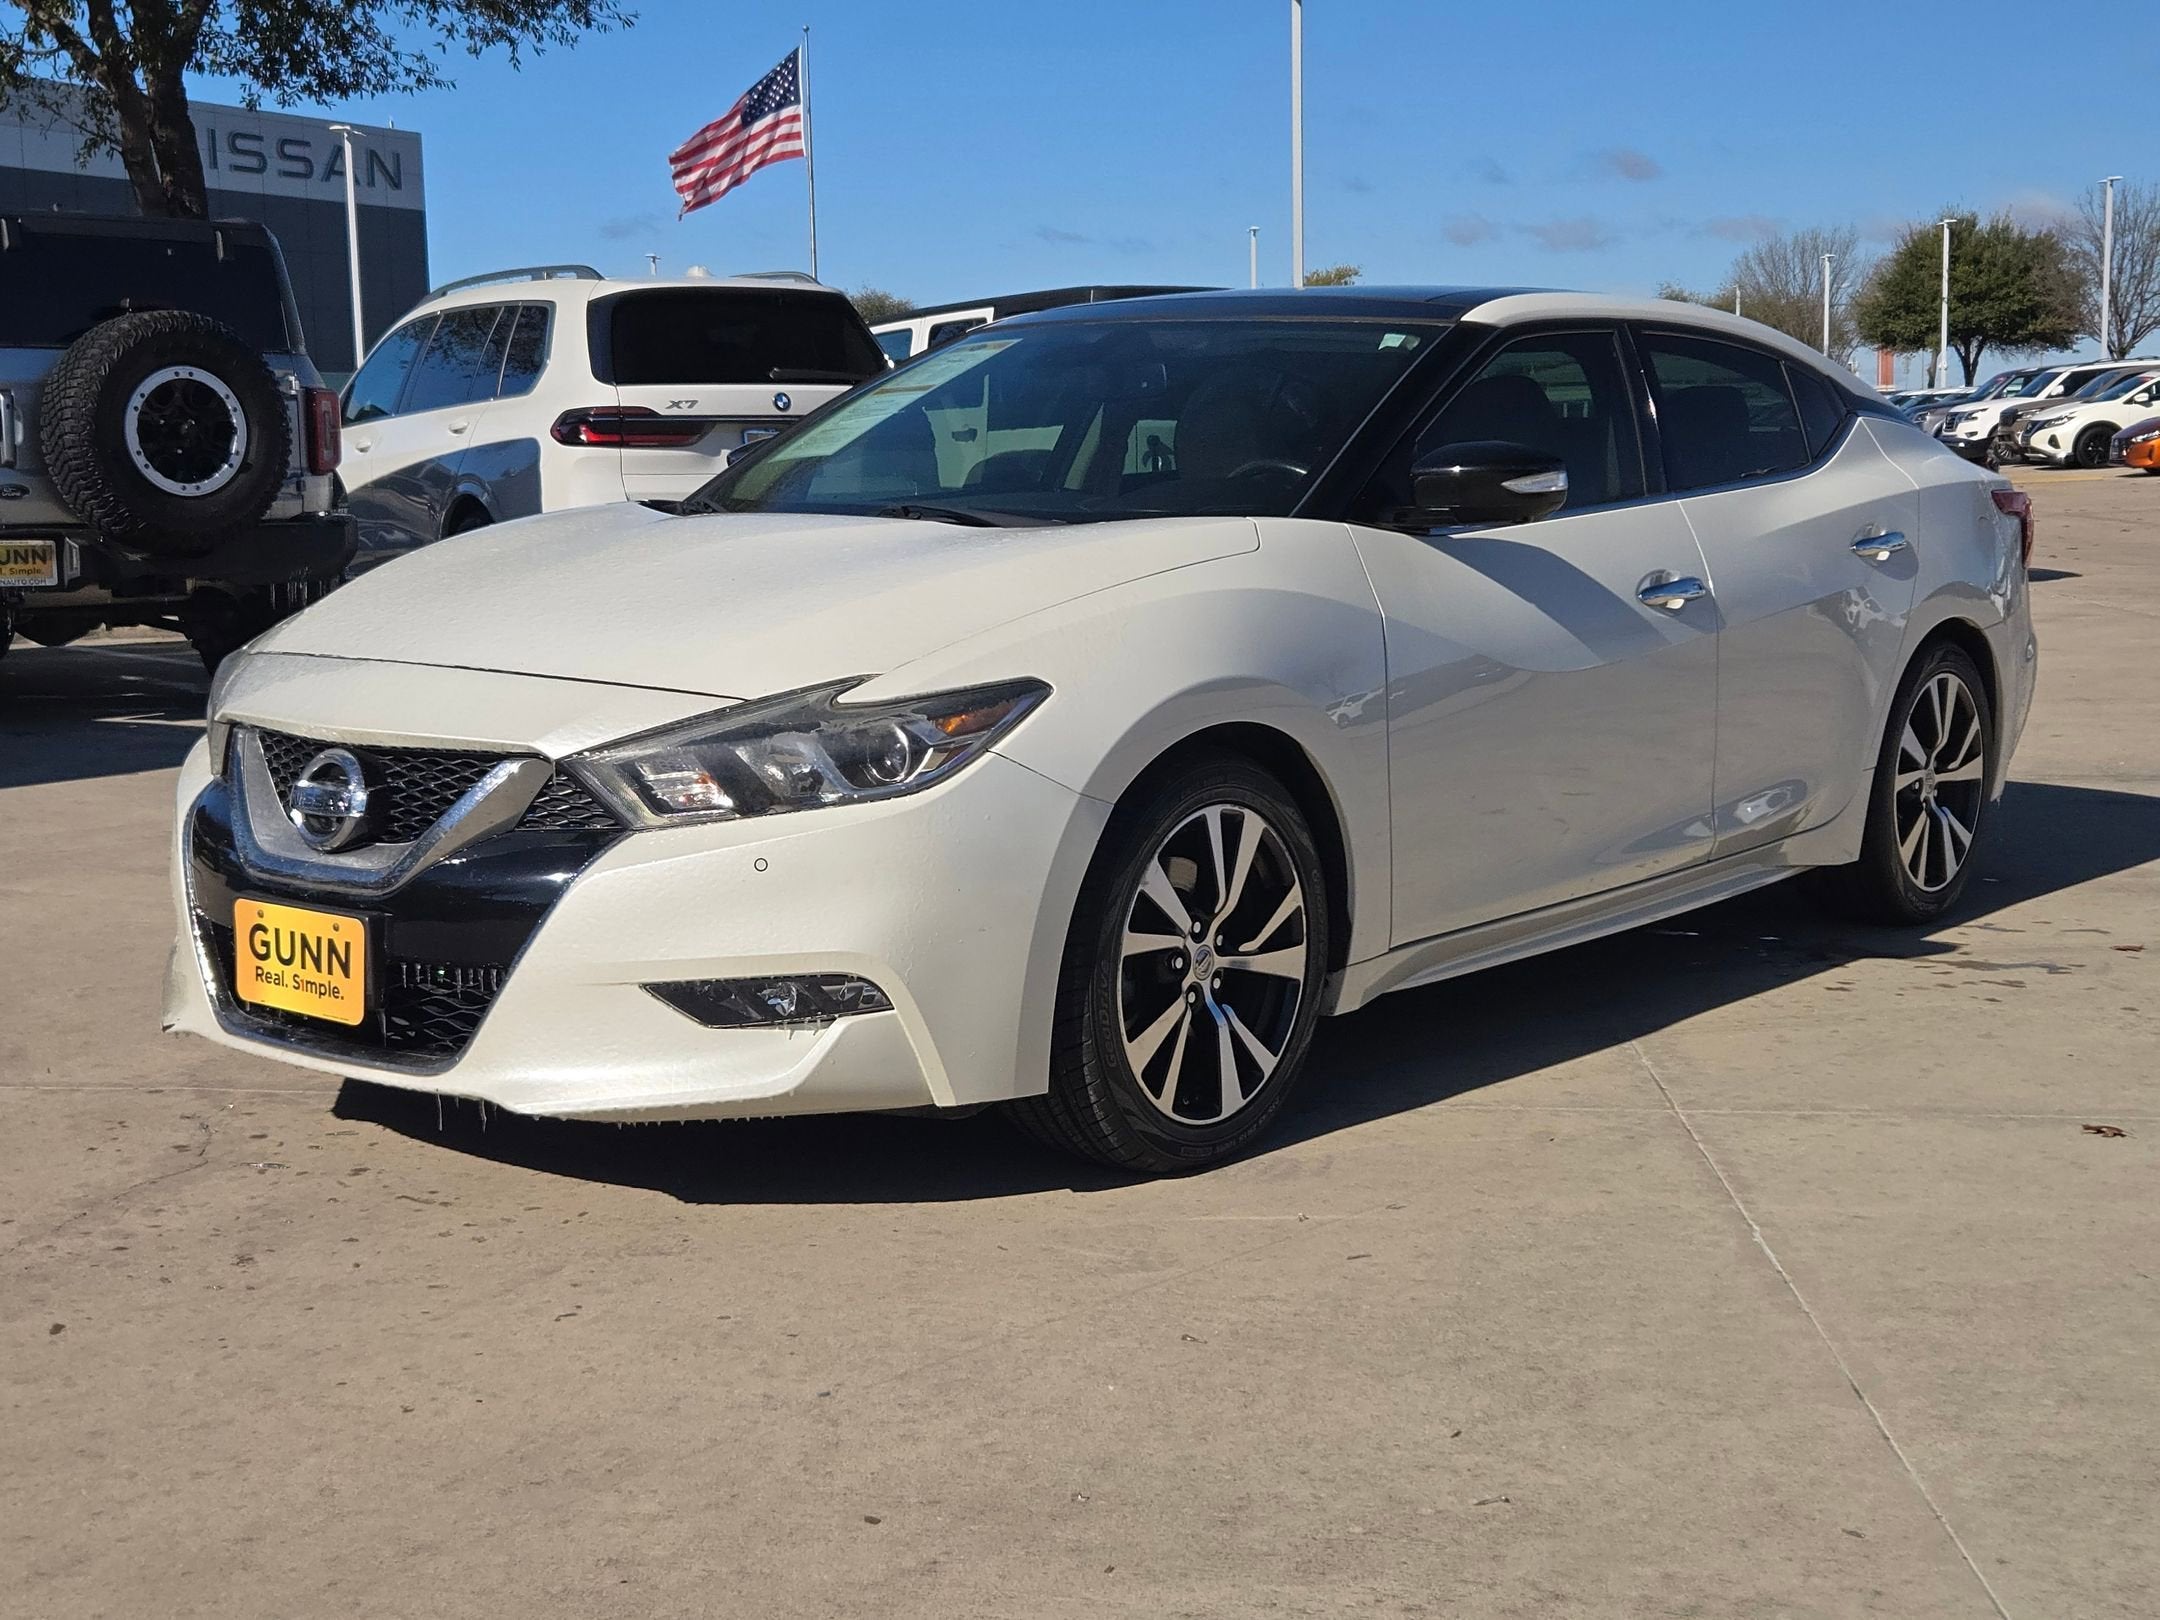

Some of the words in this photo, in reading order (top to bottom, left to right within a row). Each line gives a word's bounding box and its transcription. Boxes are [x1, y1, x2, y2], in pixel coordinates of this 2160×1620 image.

[207, 127, 403, 191] ISSAN
[665, 400, 698, 410] X7
[0, 548, 47, 565] UNN
[248, 922, 351, 979] GUNN
[255, 966, 289, 988] Real.
